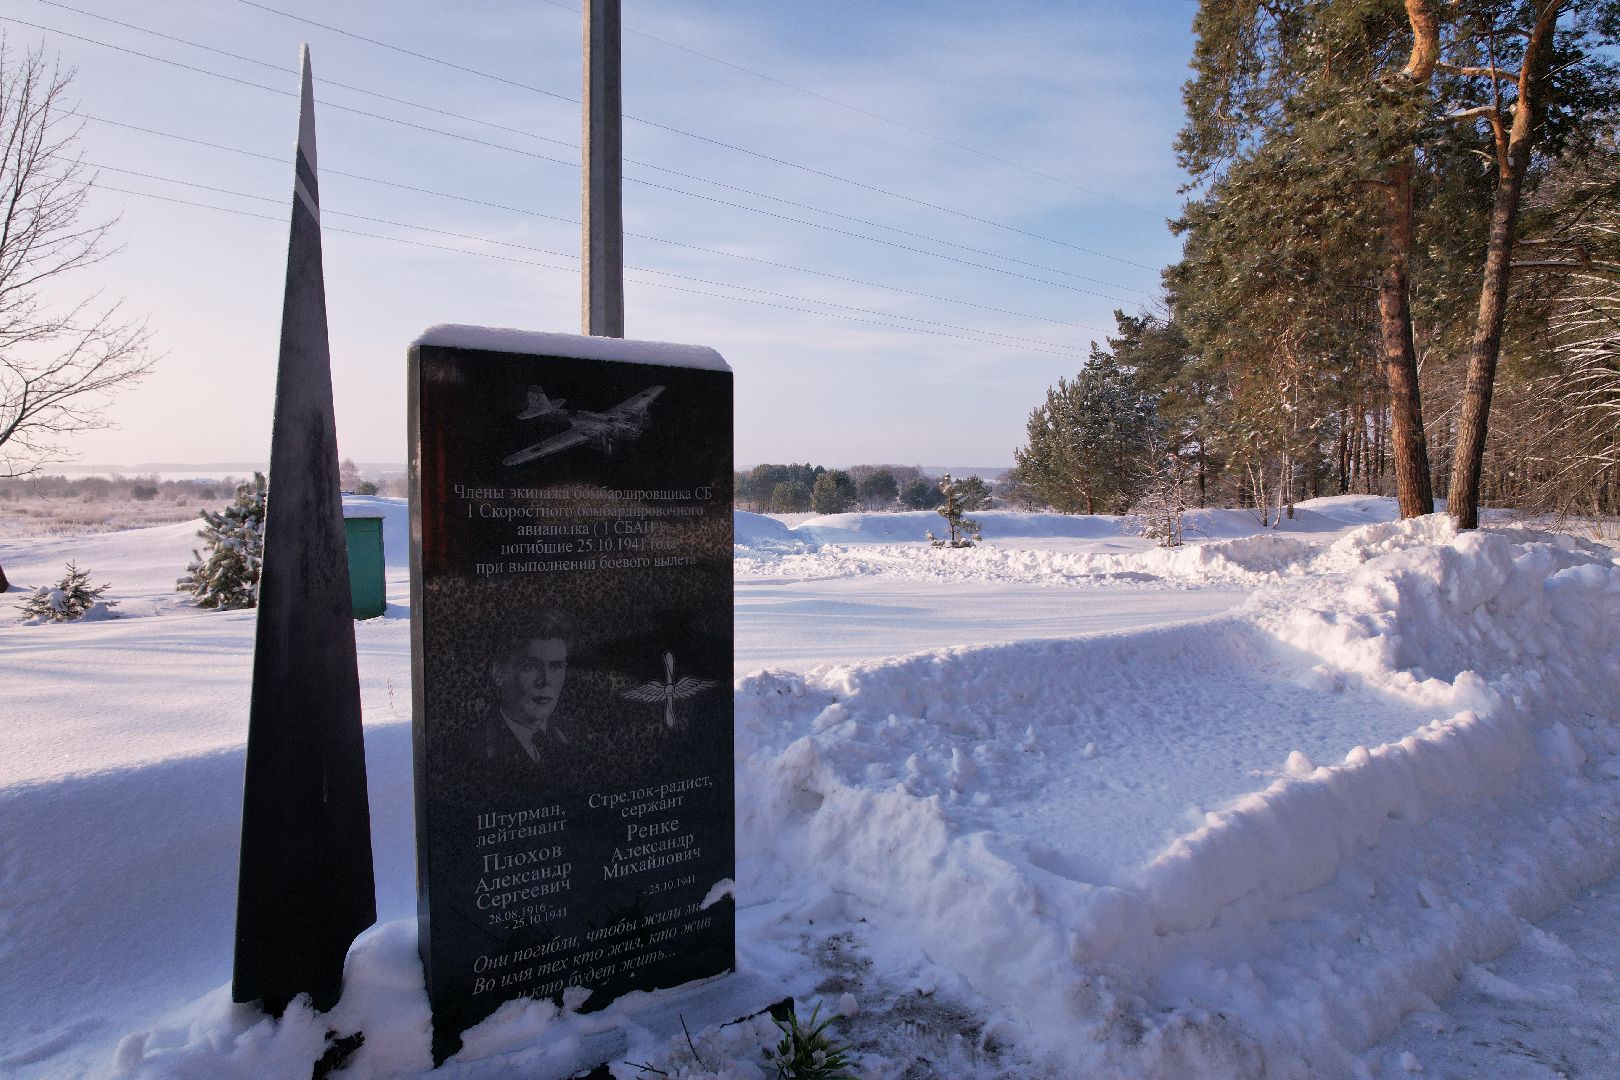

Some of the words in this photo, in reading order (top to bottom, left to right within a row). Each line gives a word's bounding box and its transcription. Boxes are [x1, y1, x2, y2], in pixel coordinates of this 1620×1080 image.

[455, 484, 504, 499] Члены
[510, 488, 570, 499] экипажа
[573, 485, 691, 502] бомбардировщика
[694, 486, 713, 500] СБ
[480, 503, 573, 522] Скоростного
[577, 503, 704, 520] бомбардировочного
[517, 525, 590, 536] авиаполка
[501, 539, 573, 555] погибшие
[577, 537, 646, 553] 25.10.1941
[476, 563, 504, 578] при
[509, 560, 596, 573] выполнении
[600, 554, 650, 569] боевого
[654, 556, 697, 568] вылета
[588, 775, 713, 809] Стрелок-радист,
[621, 796, 684, 818] сержант
[476, 819, 567, 848] лейтенант
[627, 819, 679, 841] Ренке
[482, 845, 562, 873] Плохов
[611, 833, 694, 863] Александр
[475, 862, 572, 894] Александр
[603, 847, 701, 881] Михайлович
[476, 878, 571, 910] Сергеевич
[473, 954, 509, 973] Они
[513, 935, 580, 962] погибли,
[586, 918, 637, 942] чтобы
[641, 906, 682, 928] жили
[472, 977, 496, 996] Во
[501, 967, 533, 988] имя
[537, 957, 569, 977] тех
[572, 949, 604, 967] кто
[648, 927, 678, 945] кто
